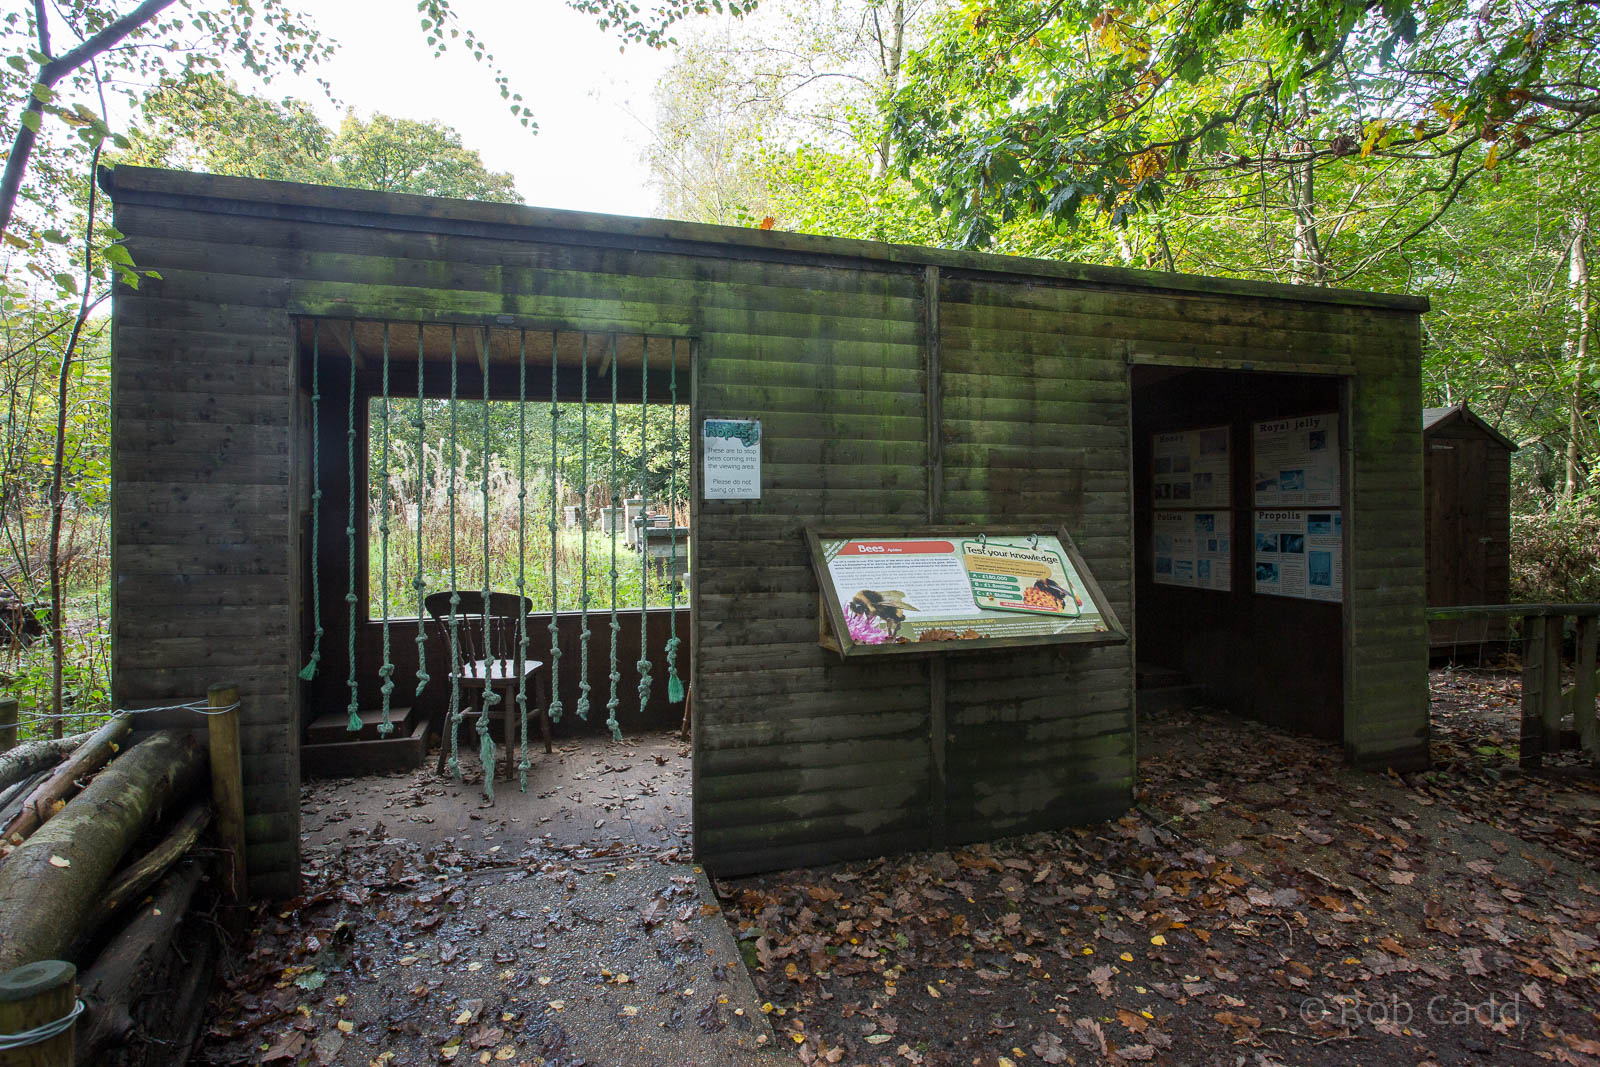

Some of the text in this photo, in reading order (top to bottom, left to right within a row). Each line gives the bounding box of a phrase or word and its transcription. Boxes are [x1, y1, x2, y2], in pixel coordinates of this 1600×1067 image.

[1259, 422, 1289, 432] Royal
[706, 425, 748, 440] Ropes
[743, 447, 757, 455] stop
[1258, 511, 1301, 522] Propolis
[857, 544, 885, 553] Bees
[966, 546, 986, 555] Test
[1009, 551, 1059, 564] knowledge
